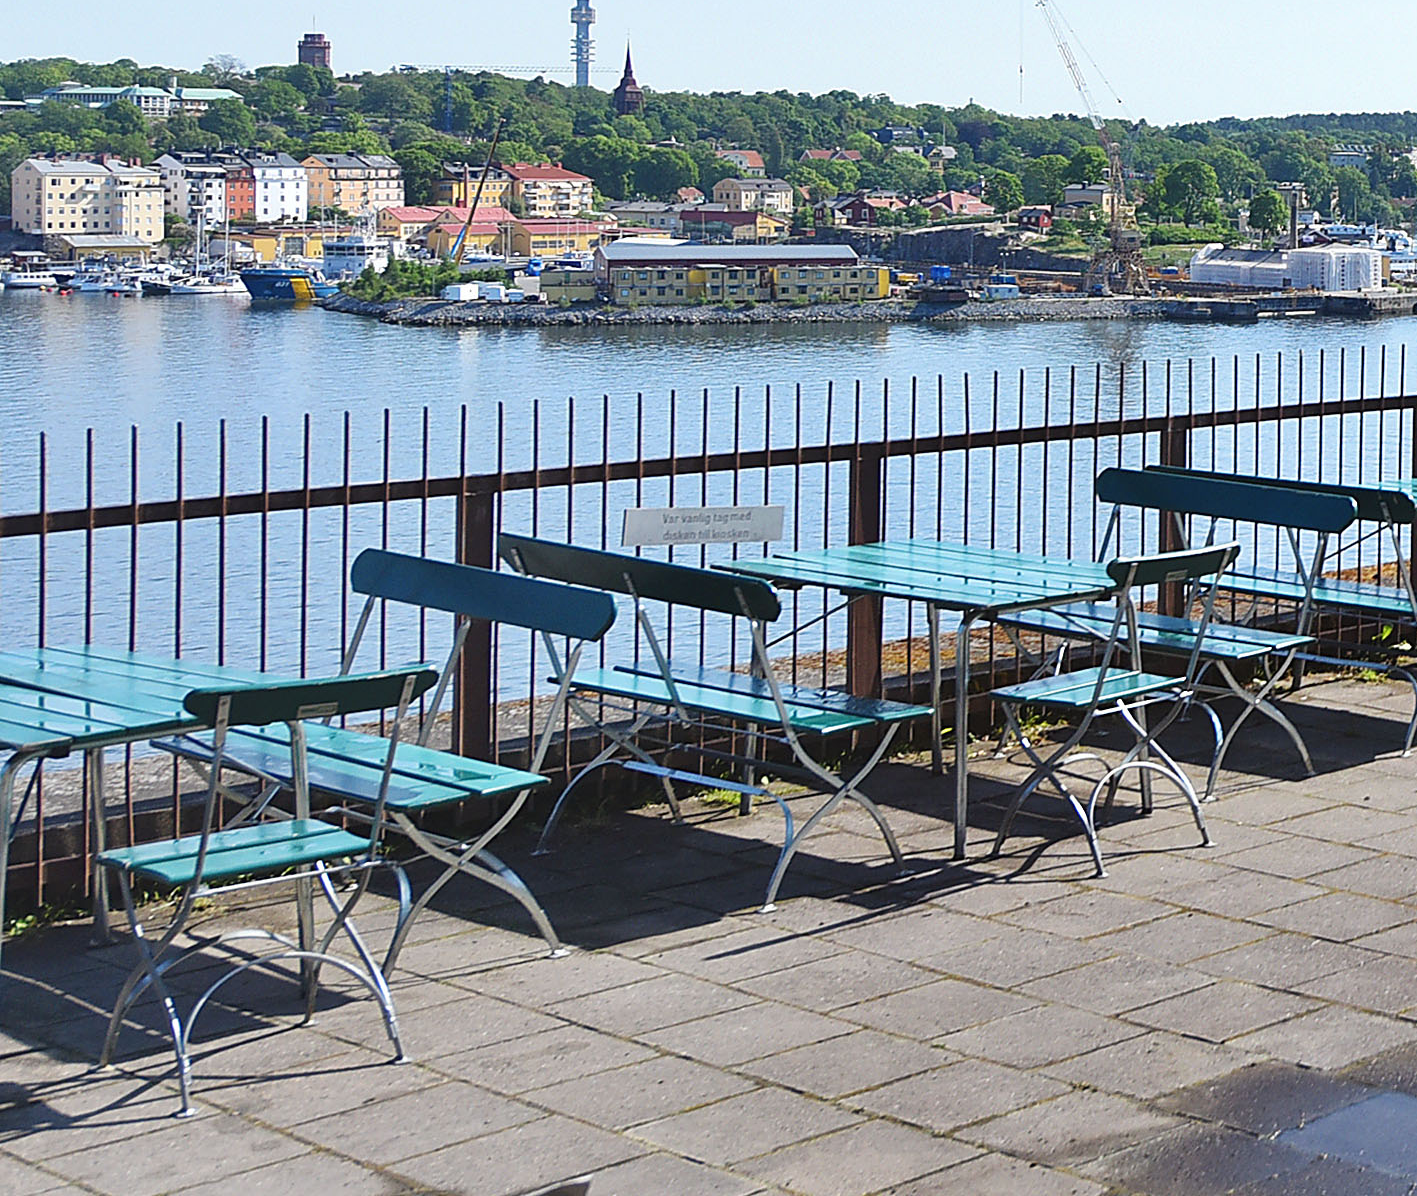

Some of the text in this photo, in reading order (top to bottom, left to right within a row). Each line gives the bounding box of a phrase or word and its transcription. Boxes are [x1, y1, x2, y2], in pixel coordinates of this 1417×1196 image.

[712, 513, 729, 525] tag
[730, 511, 751, 521] med
[663, 528, 749, 540] disken till kiosken
